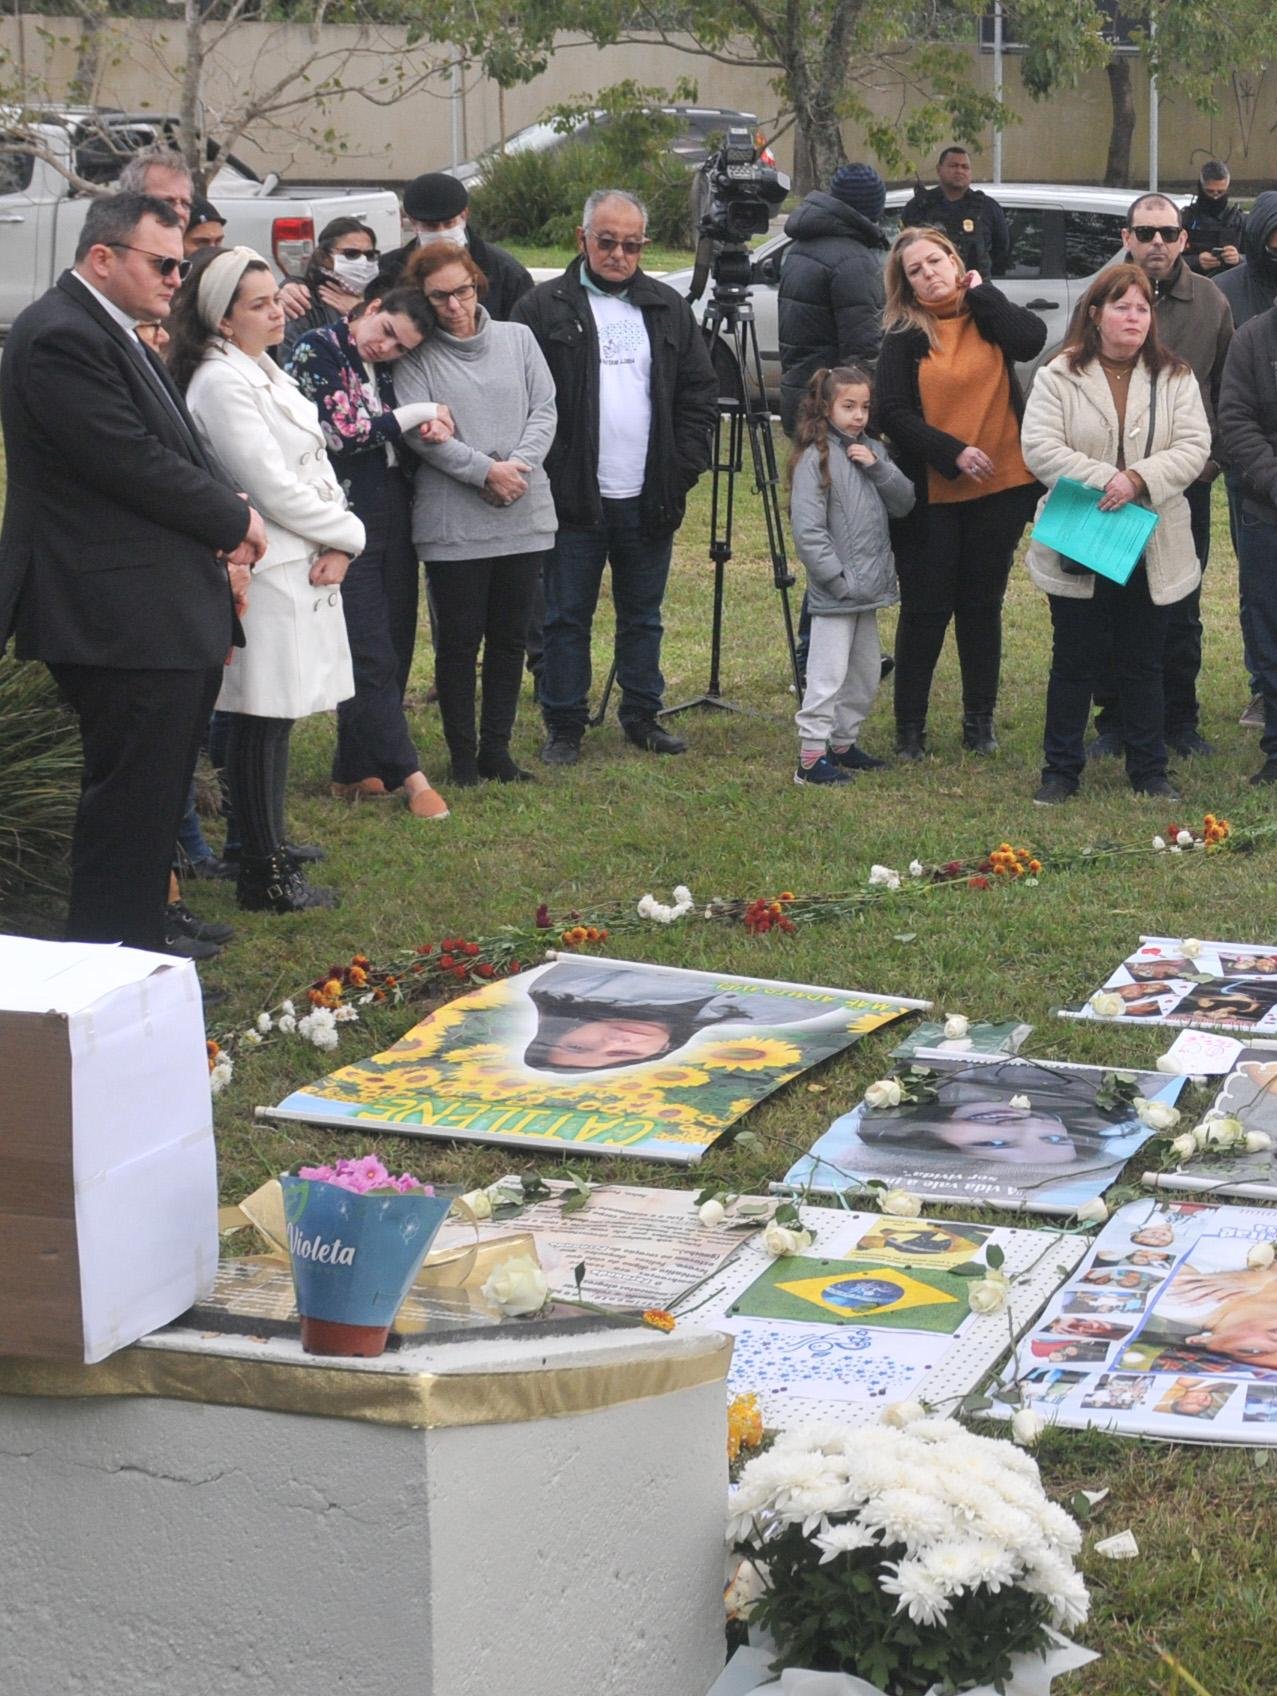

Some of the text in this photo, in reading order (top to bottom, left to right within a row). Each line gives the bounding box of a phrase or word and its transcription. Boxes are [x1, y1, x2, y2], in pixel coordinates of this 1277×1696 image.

[354, 1101, 655, 1147] CATILENE
[963, 1182, 1000, 1192] vida
[287, 1222, 355, 1266] Violeta
